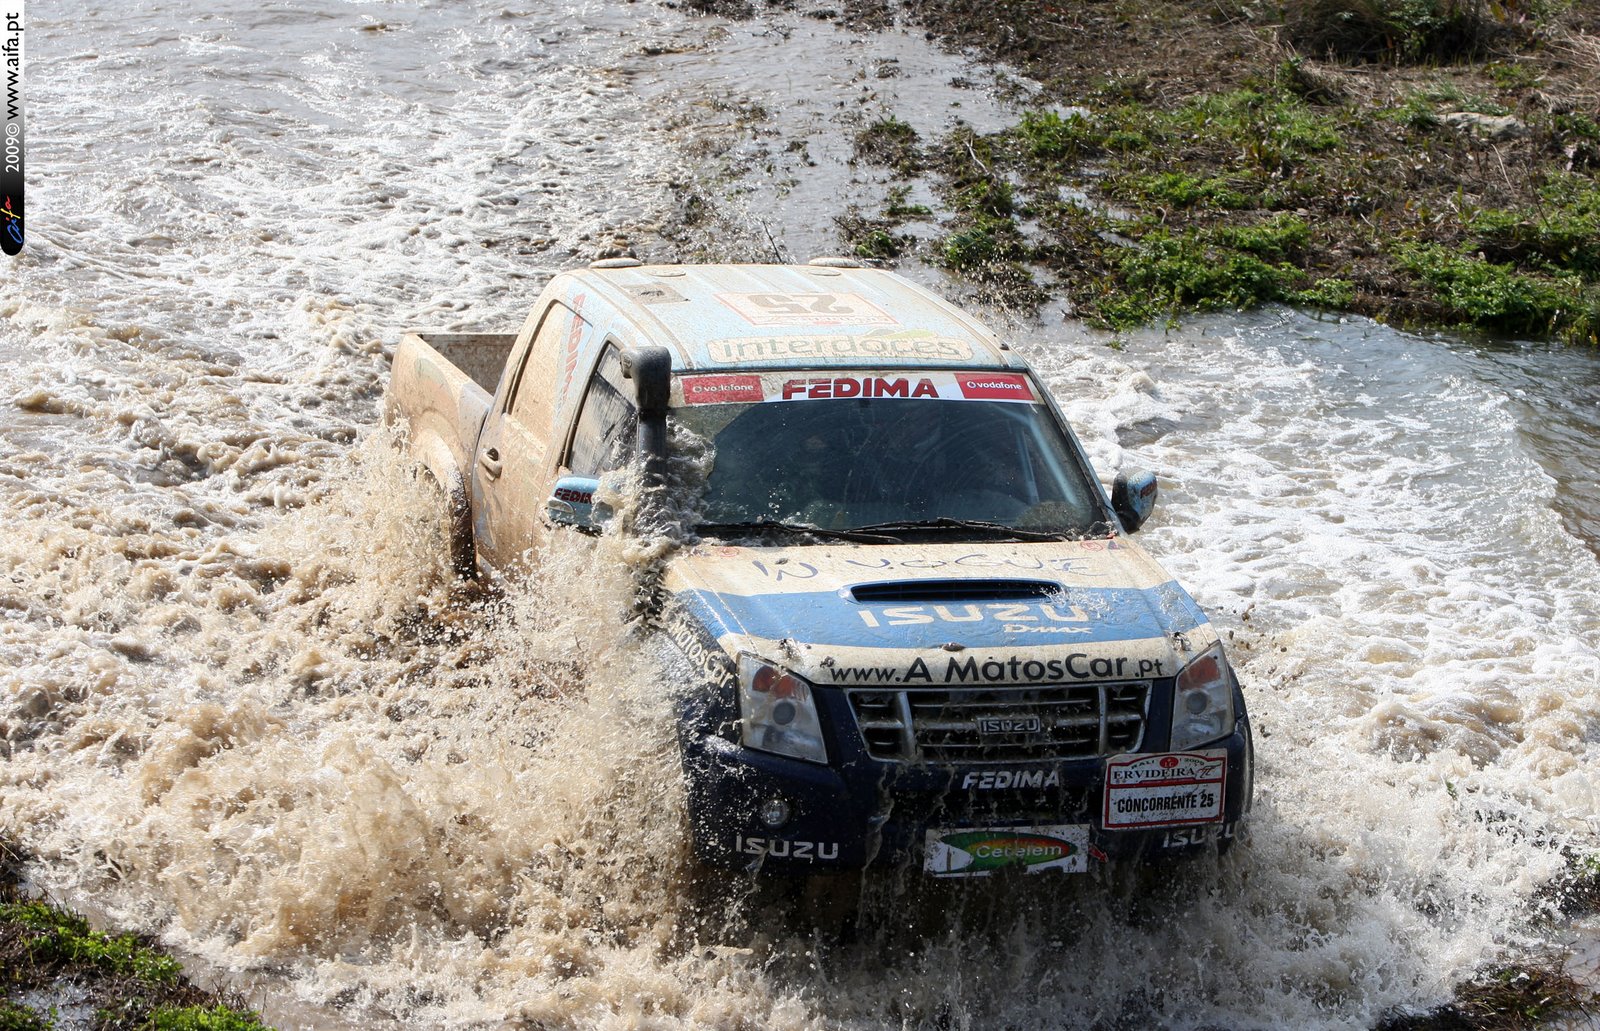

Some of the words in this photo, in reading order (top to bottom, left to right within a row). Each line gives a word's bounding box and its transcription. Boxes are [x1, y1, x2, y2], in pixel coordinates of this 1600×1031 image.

[782, 377, 940, 400] FEDIMA
[976, 380, 1023, 390] vodafone
[858, 603, 1089, 627] ISUZU
[983, 720, 1037, 732] ISUZU
[962, 770, 1060, 790] FEDIMA
[1113, 767, 1195, 780] ERVIDEIRA
[1117, 793, 1197, 814] CONCORRENTE
[1200, 793, 1214, 808] 25
[735, 834, 839, 860] ISUZU
[976, 845, 1062, 858] Cetelem
